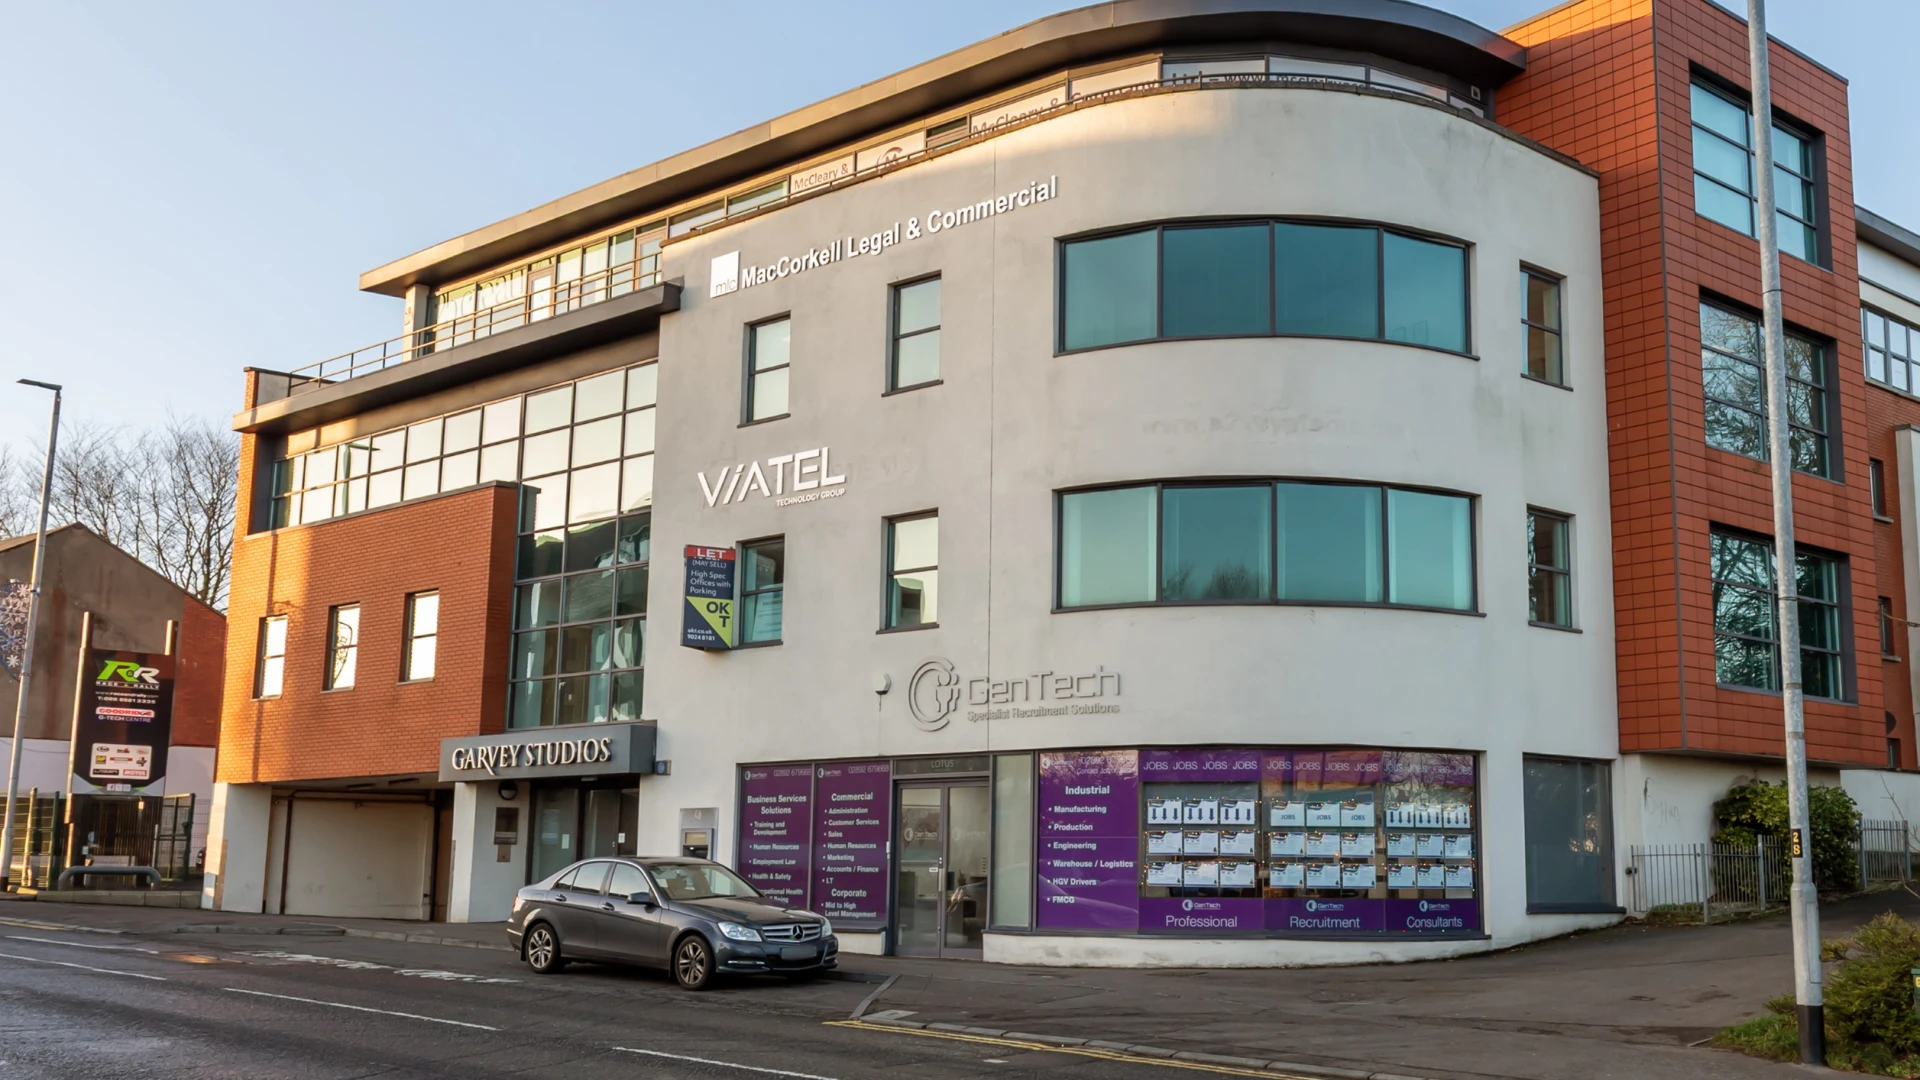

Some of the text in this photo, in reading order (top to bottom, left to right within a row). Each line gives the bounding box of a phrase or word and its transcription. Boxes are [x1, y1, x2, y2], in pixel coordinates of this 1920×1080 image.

[794, 163, 849, 190] McCleary &
[741, 175, 1057, 289] MacCorkell Legal & Commercial
[776, 488, 846, 507] TECHNOLOGY GROUP
[697, 548, 726, 559] LET
[691, 570, 727, 580] High Spec
[690, 579, 731, 588] Offices with
[690, 587, 717, 596] Parking
[968, 665, 1121, 705] GenTech
[99, 708, 152, 716] GOODRIDGE
[967, 702, 1120, 722] Specialist Recruitment Solutions
[452, 737, 612, 776] GARVEY STUDIOS
[931, 760, 954, 768] LOTUS
[1143, 761, 1168, 771] JOBS
[1172, 761, 1198, 771] JOBS
[1202, 761, 1227, 770] JOBS
[1232, 760, 1258, 770] JOBS
[1266, 760, 1379, 772] JOBS JOBS JOBS JOBS
[848, 766, 867, 774] 02892
[1065, 785, 1110, 795] Industrial
[747, 795, 777, 803] Business
[831, 792, 874, 802] Commercial
[761, 806, 792, 814] Solutions
[1053, 804, 1107, 814] Manufacturing
[754, 821, 774, 829] Training
[1053, 822, 1094, 831] Production
[1053, 841, 1097, 851] Engineering
[752, 858, 784, 866] Employment
[827, 854, 855, 862] Marketing
[1053, 859, 1093, 868] Warehouse
[1099, 859, 1134, 869] Logistics
[774, 873, 791, 881] Safety
[1052, 877, 1097, 886] HGV Drivers
[831, 888, 867, 899] Corporate
[1052, 896, 1075, 904] FMCG
[843, 902, 857, 910] High
[840, 911, 877, 919] Management
[1165, 915, 1238, 928] Professional
[1289, 916, 1360, 928] Recruitment
[1406, 916, 1463, 928] Consultants
